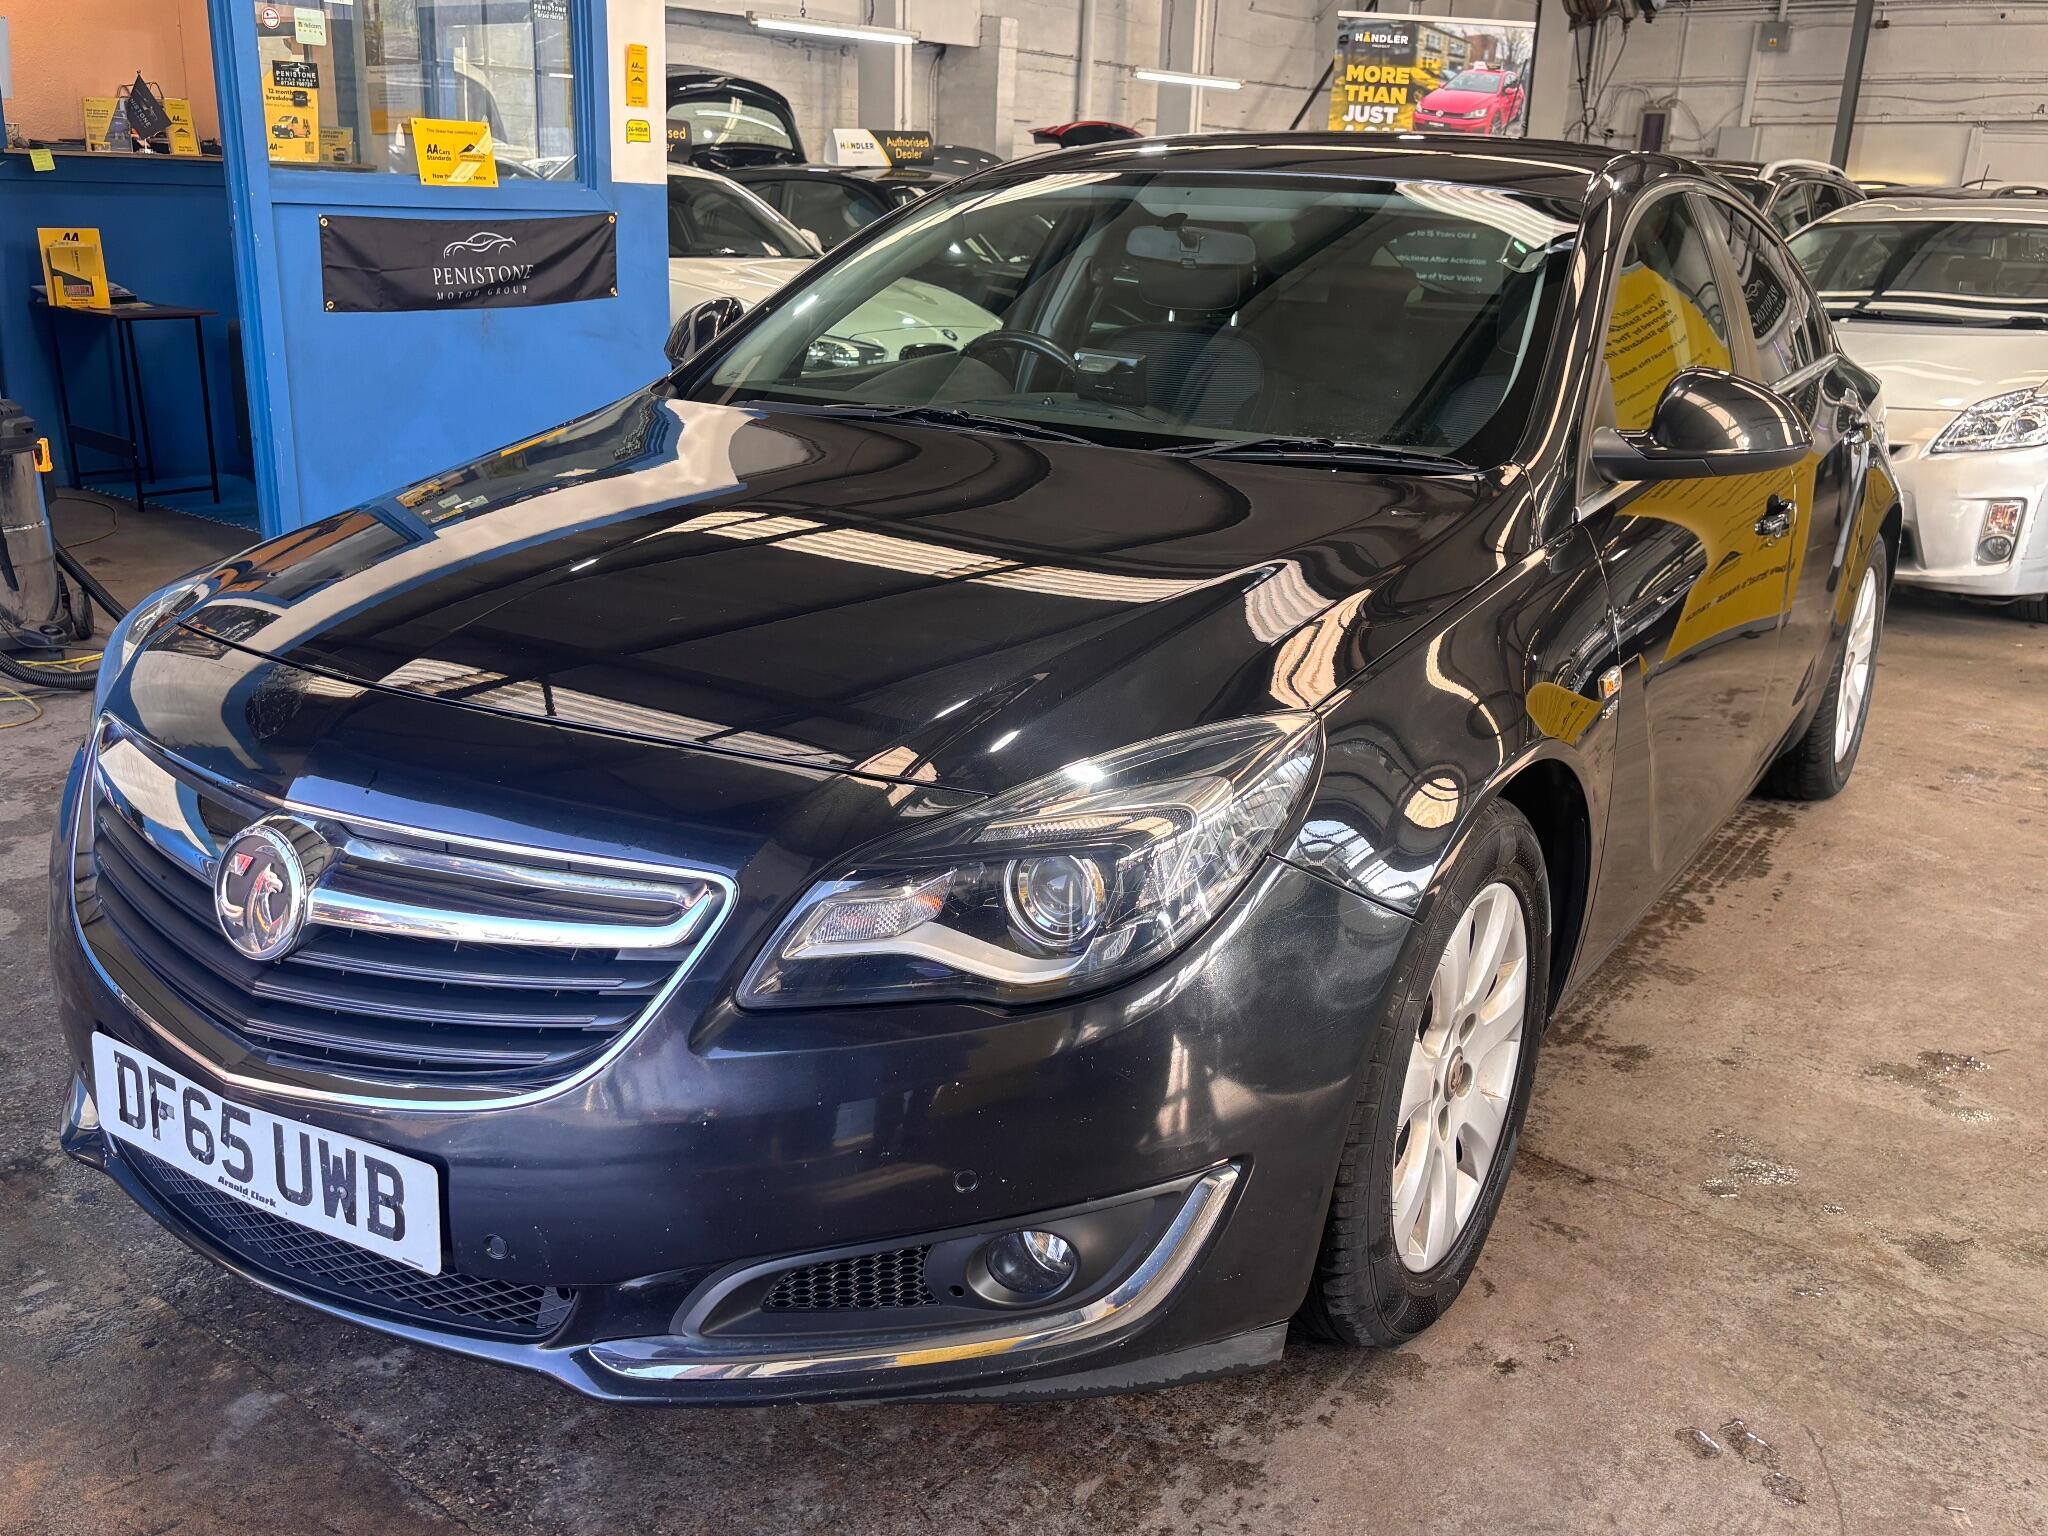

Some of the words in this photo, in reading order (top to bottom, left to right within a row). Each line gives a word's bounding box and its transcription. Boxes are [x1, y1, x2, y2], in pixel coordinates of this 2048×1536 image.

[275, 69, 317, 79] PENISTONE
[1346, 64, 1411, 85] MORE
[1345, 84, 1408, 105] THAN
[1342, 105, 1399, 125] JUST
[426, 143, 439, 154] AA
[887, 137, 929, 148] Authorised
[896, 148, 922, 159] Dealer
[1430, 255, 1449, 264] After
[432, 264, 534, 285] PENISTONE
[436, 290, 481, 301] MOTOR
[487, 285, 528, 296] GROUP
[113, 1049, 254, 1184] DF65
[272, 1121, 406, 1242] UWB
[217, 1175, 249, 1198] Arnold
[250, 1187, 277, 1208] Clark
